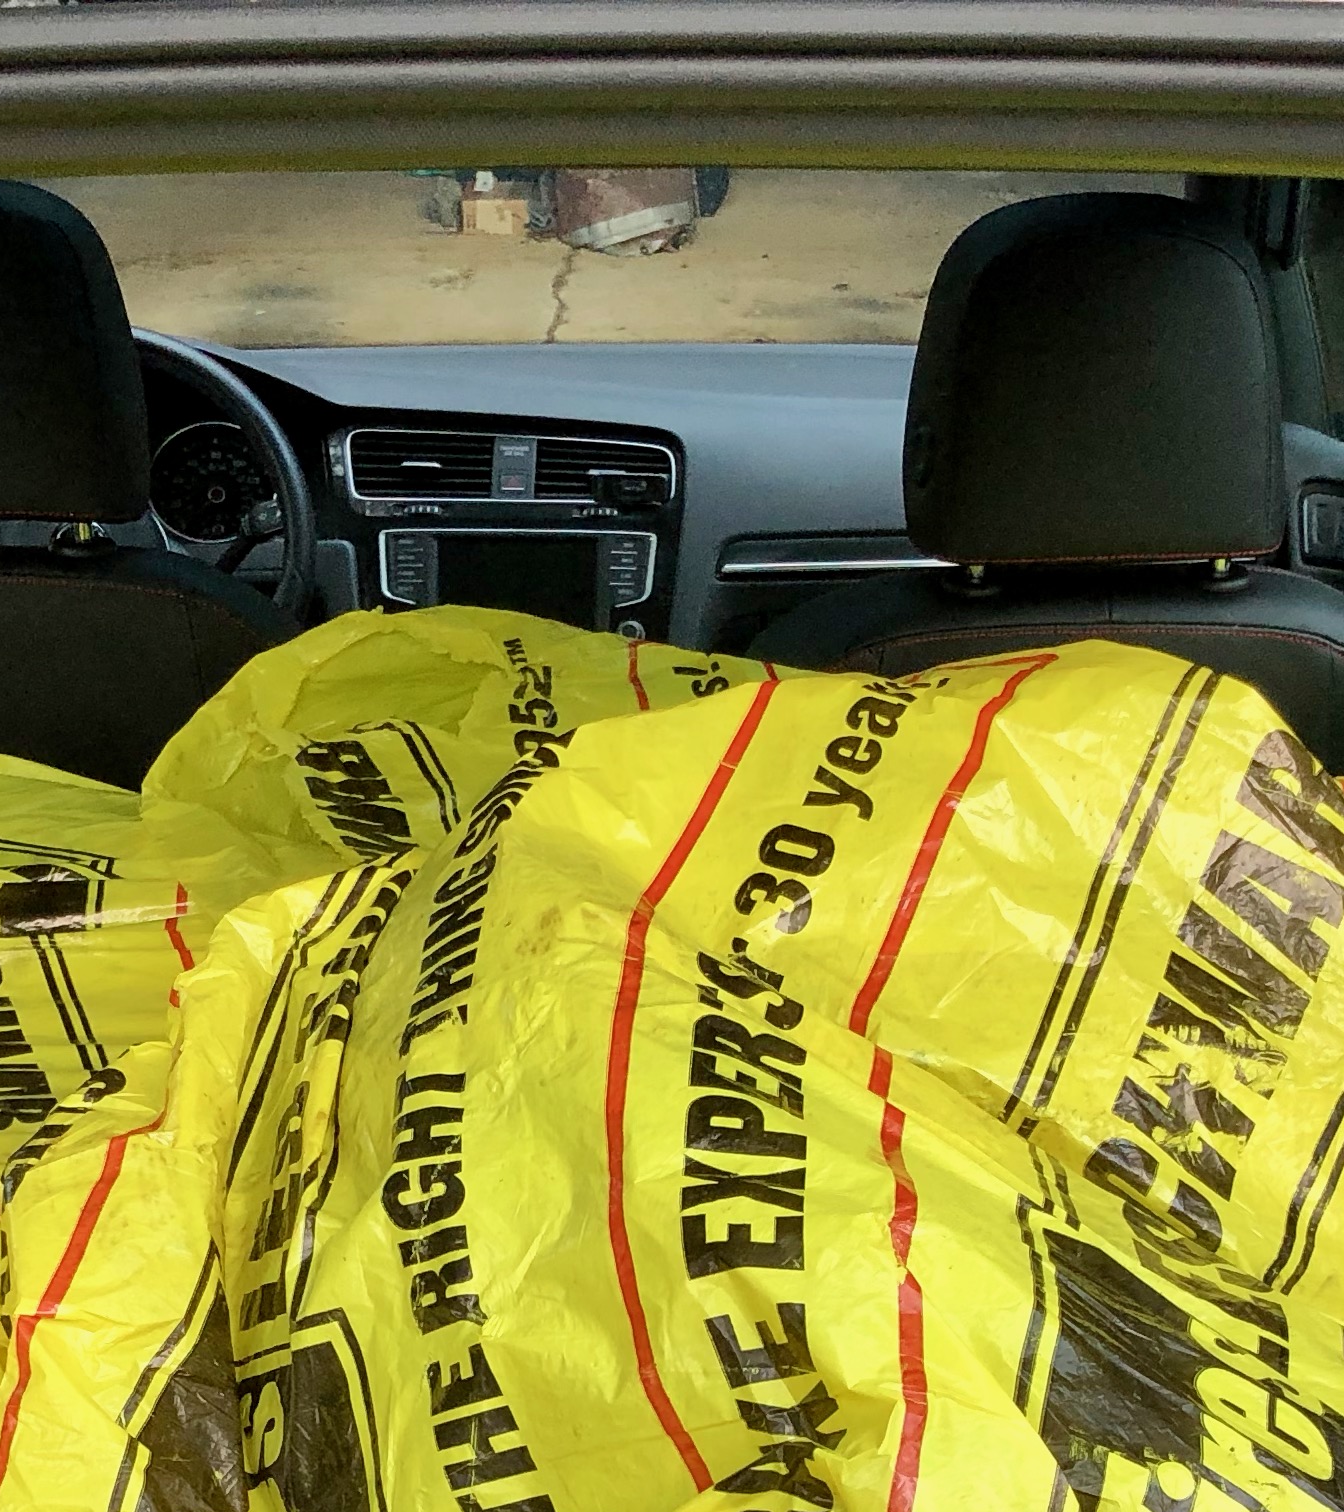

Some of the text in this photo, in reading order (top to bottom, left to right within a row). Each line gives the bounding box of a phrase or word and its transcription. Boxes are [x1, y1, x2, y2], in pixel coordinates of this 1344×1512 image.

[735, 822, 836, 936] 30
[380, 1070, 489, 1334] RIGHT
[678, 950, 810, 1279] EXPERS
